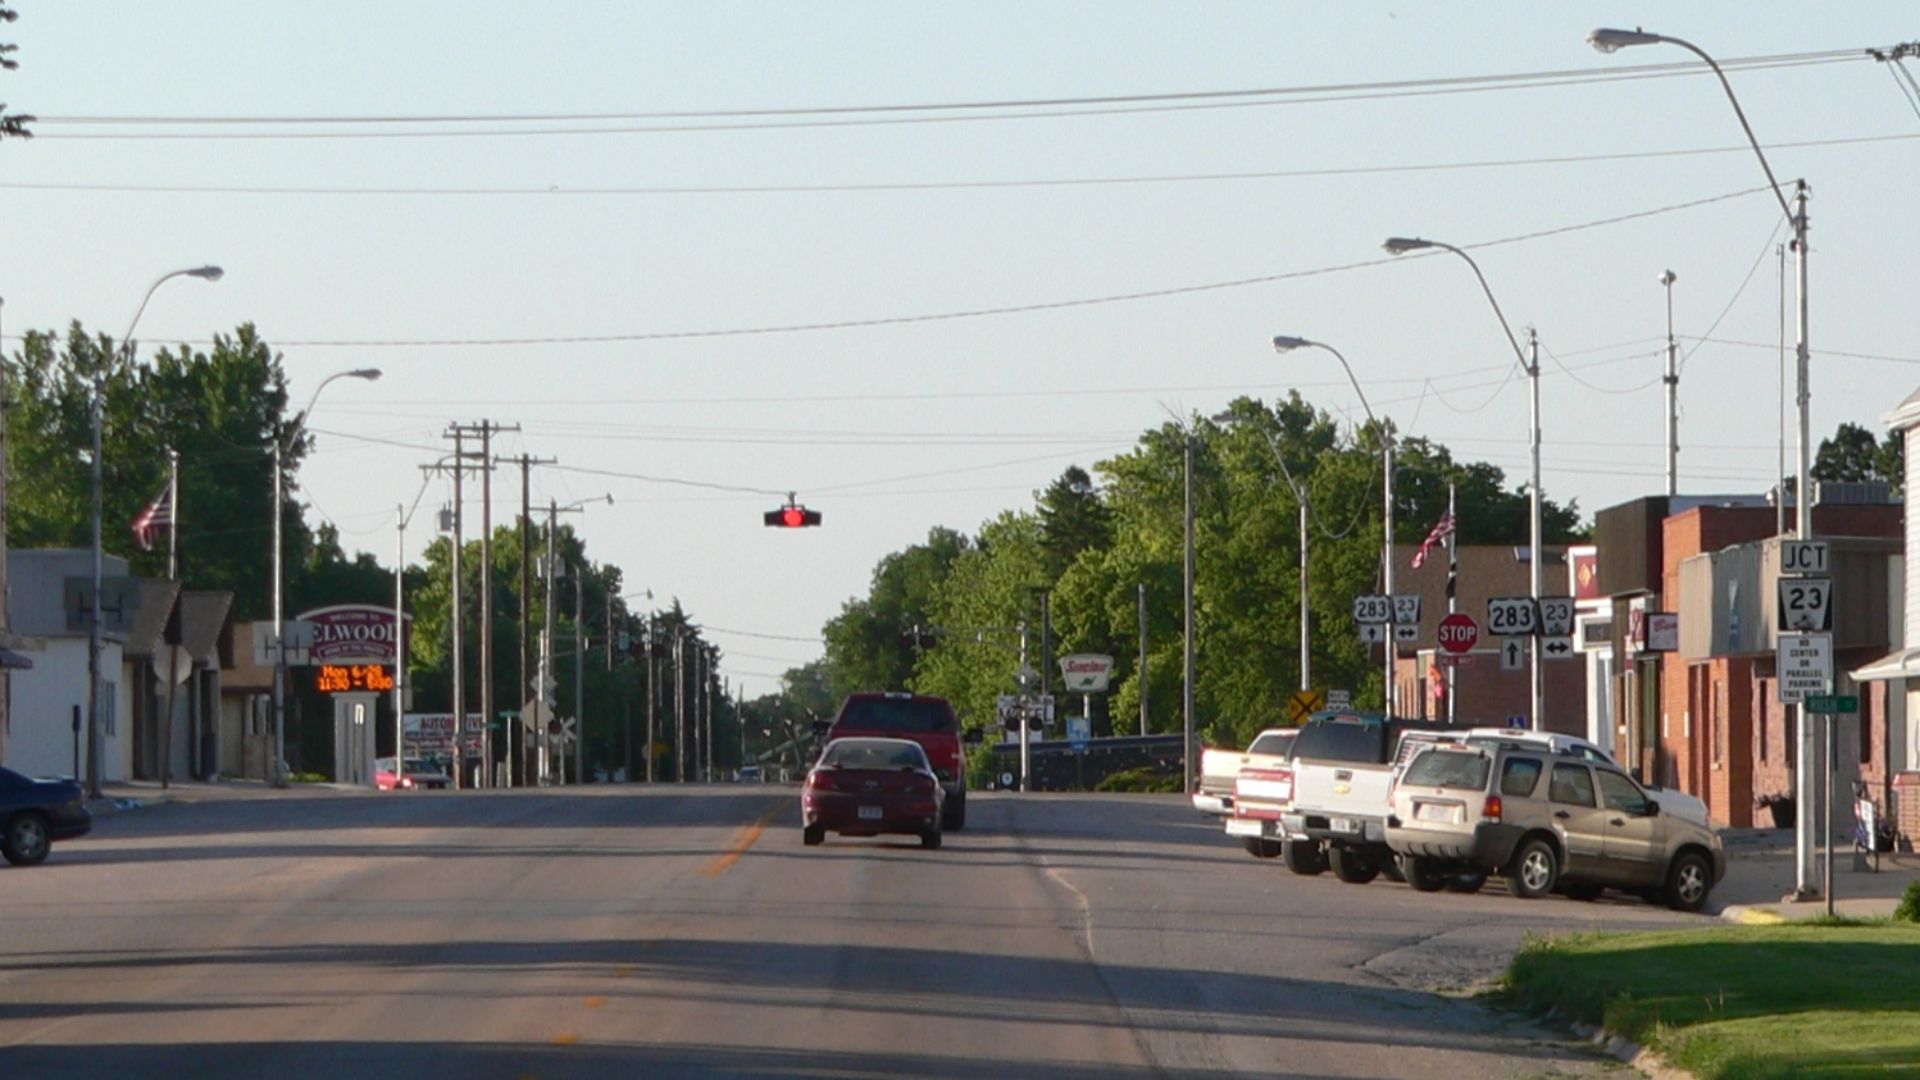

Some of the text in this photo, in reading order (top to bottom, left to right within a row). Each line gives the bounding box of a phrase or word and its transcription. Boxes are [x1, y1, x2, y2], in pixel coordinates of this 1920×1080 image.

[1785, 545, 1826, 569] JCT
[1789, 587, 1823, 610] 23
[1358, 601, 1387, 618] 283
[1397, 599, 1416, 612] 23
[1545, 604, 1568, 620] 23
[1493, 605, 1531, 627] 283
[1440, 625, 1476, 642] STOP
[1799, 639, 1810, 647] NO
[1790, 649, 1819, 658] CENTER
[1799, 659, 1810, 668] OR
[1786, 669, 1823, 678] PARALLEL
[1788, 679, 1822, 688] PARKING
[1783, 690, 1800, 698] THIS
